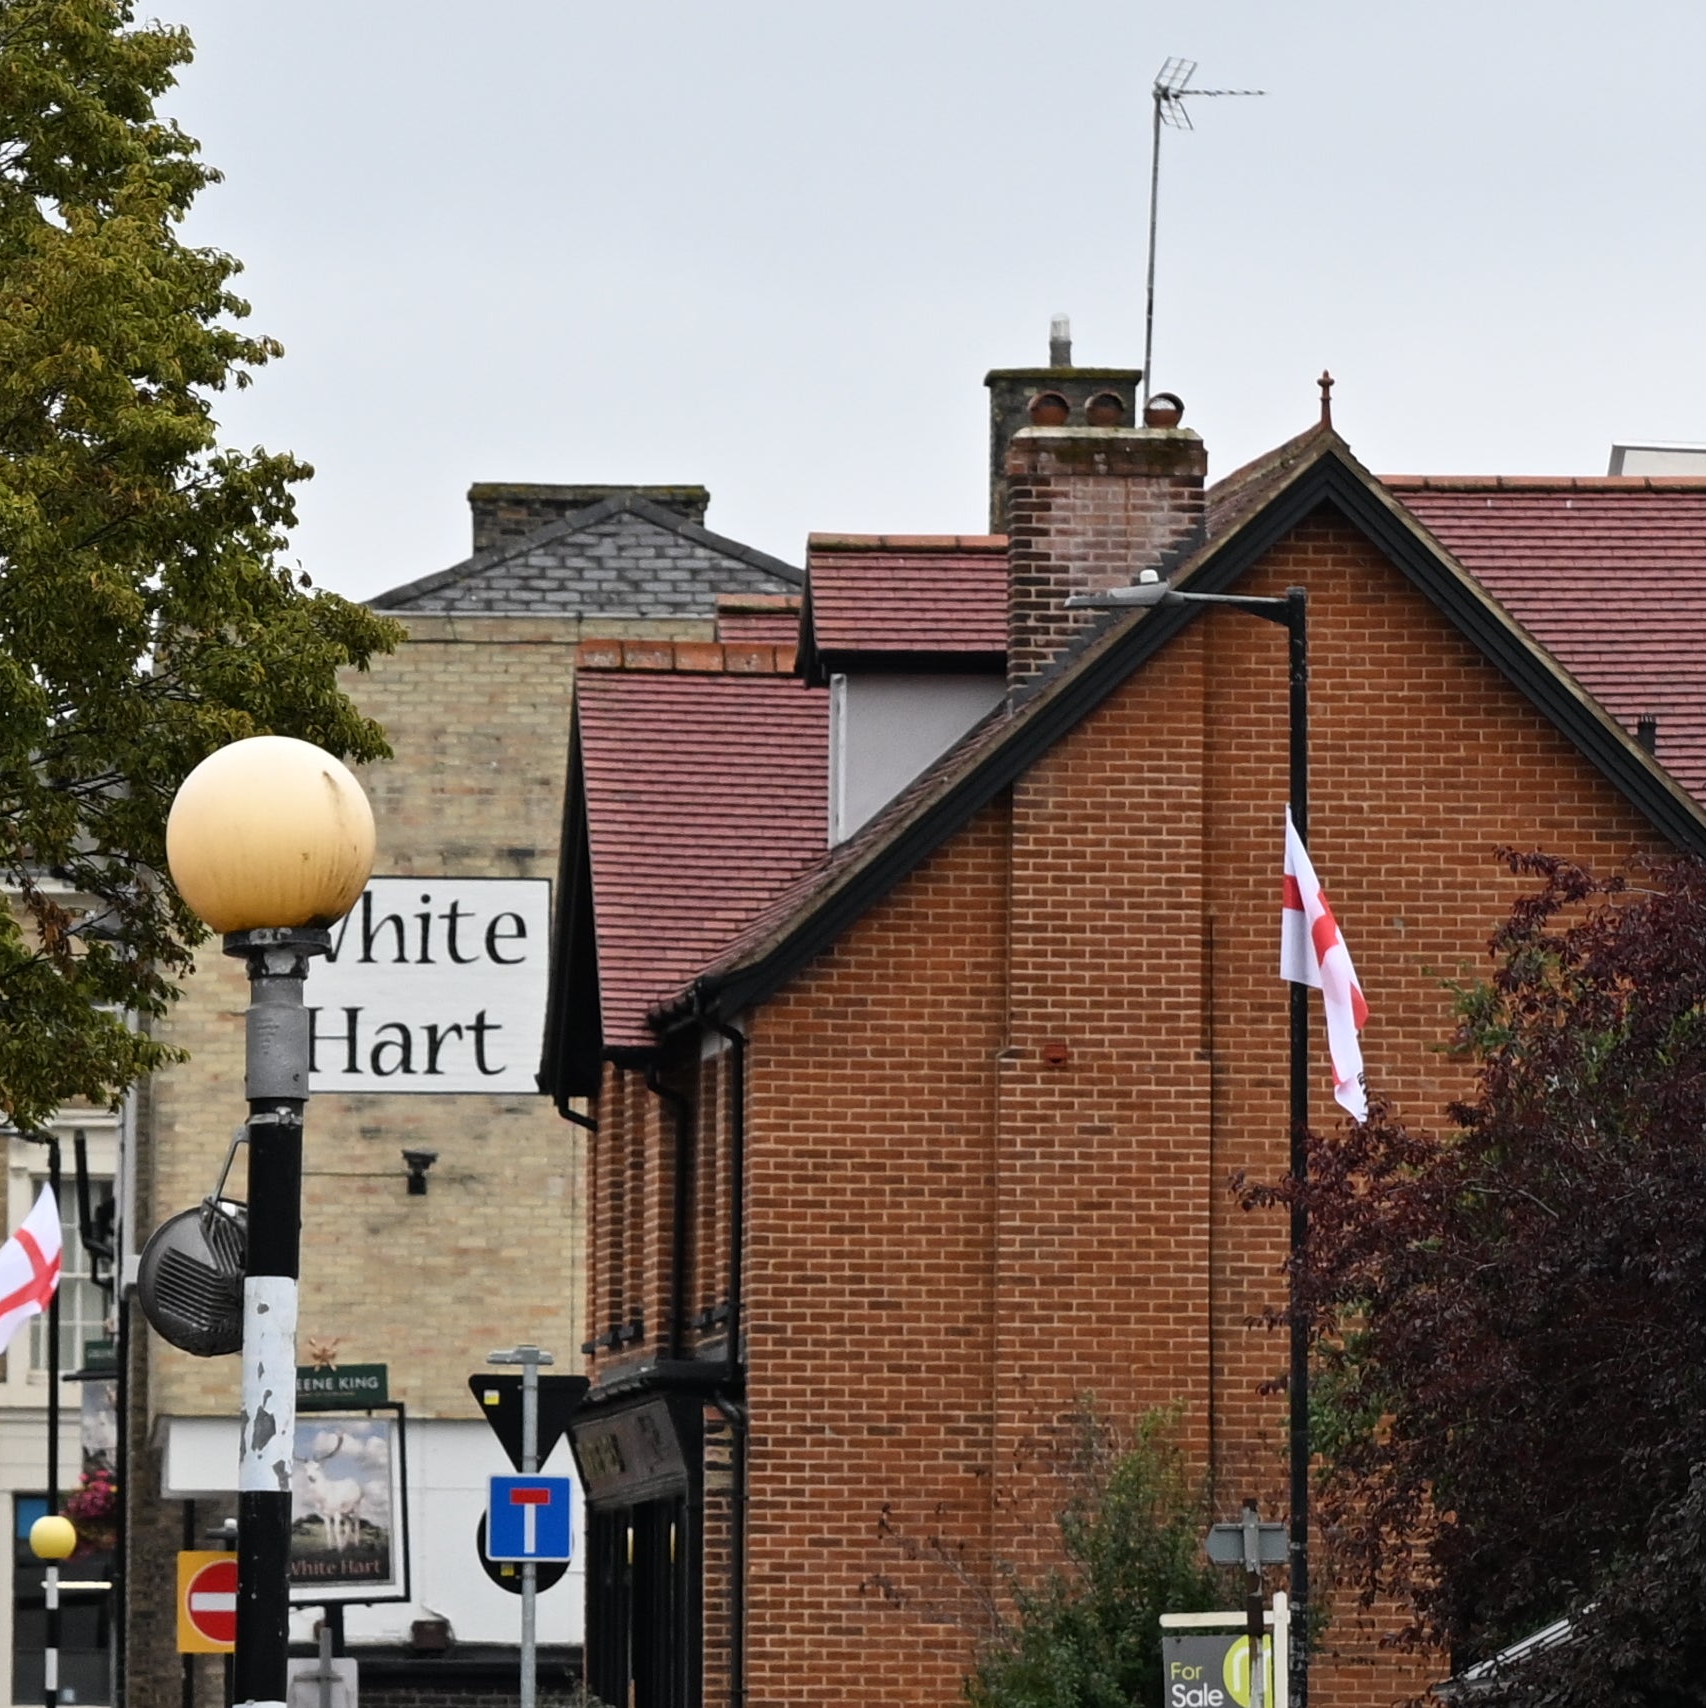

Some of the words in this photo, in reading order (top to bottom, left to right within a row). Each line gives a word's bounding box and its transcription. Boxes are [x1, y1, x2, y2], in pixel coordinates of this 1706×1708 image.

[309, 1007, 507, 1076] Hart
[295, 1378, 334, 1391] EENE
[339, 1376, 379, 1389] KING
[341, 1560, 380, 1574] Hart
[1170, 1661, 1203, 1680] For
[1171, 1682, 1224, 1708] Sale
